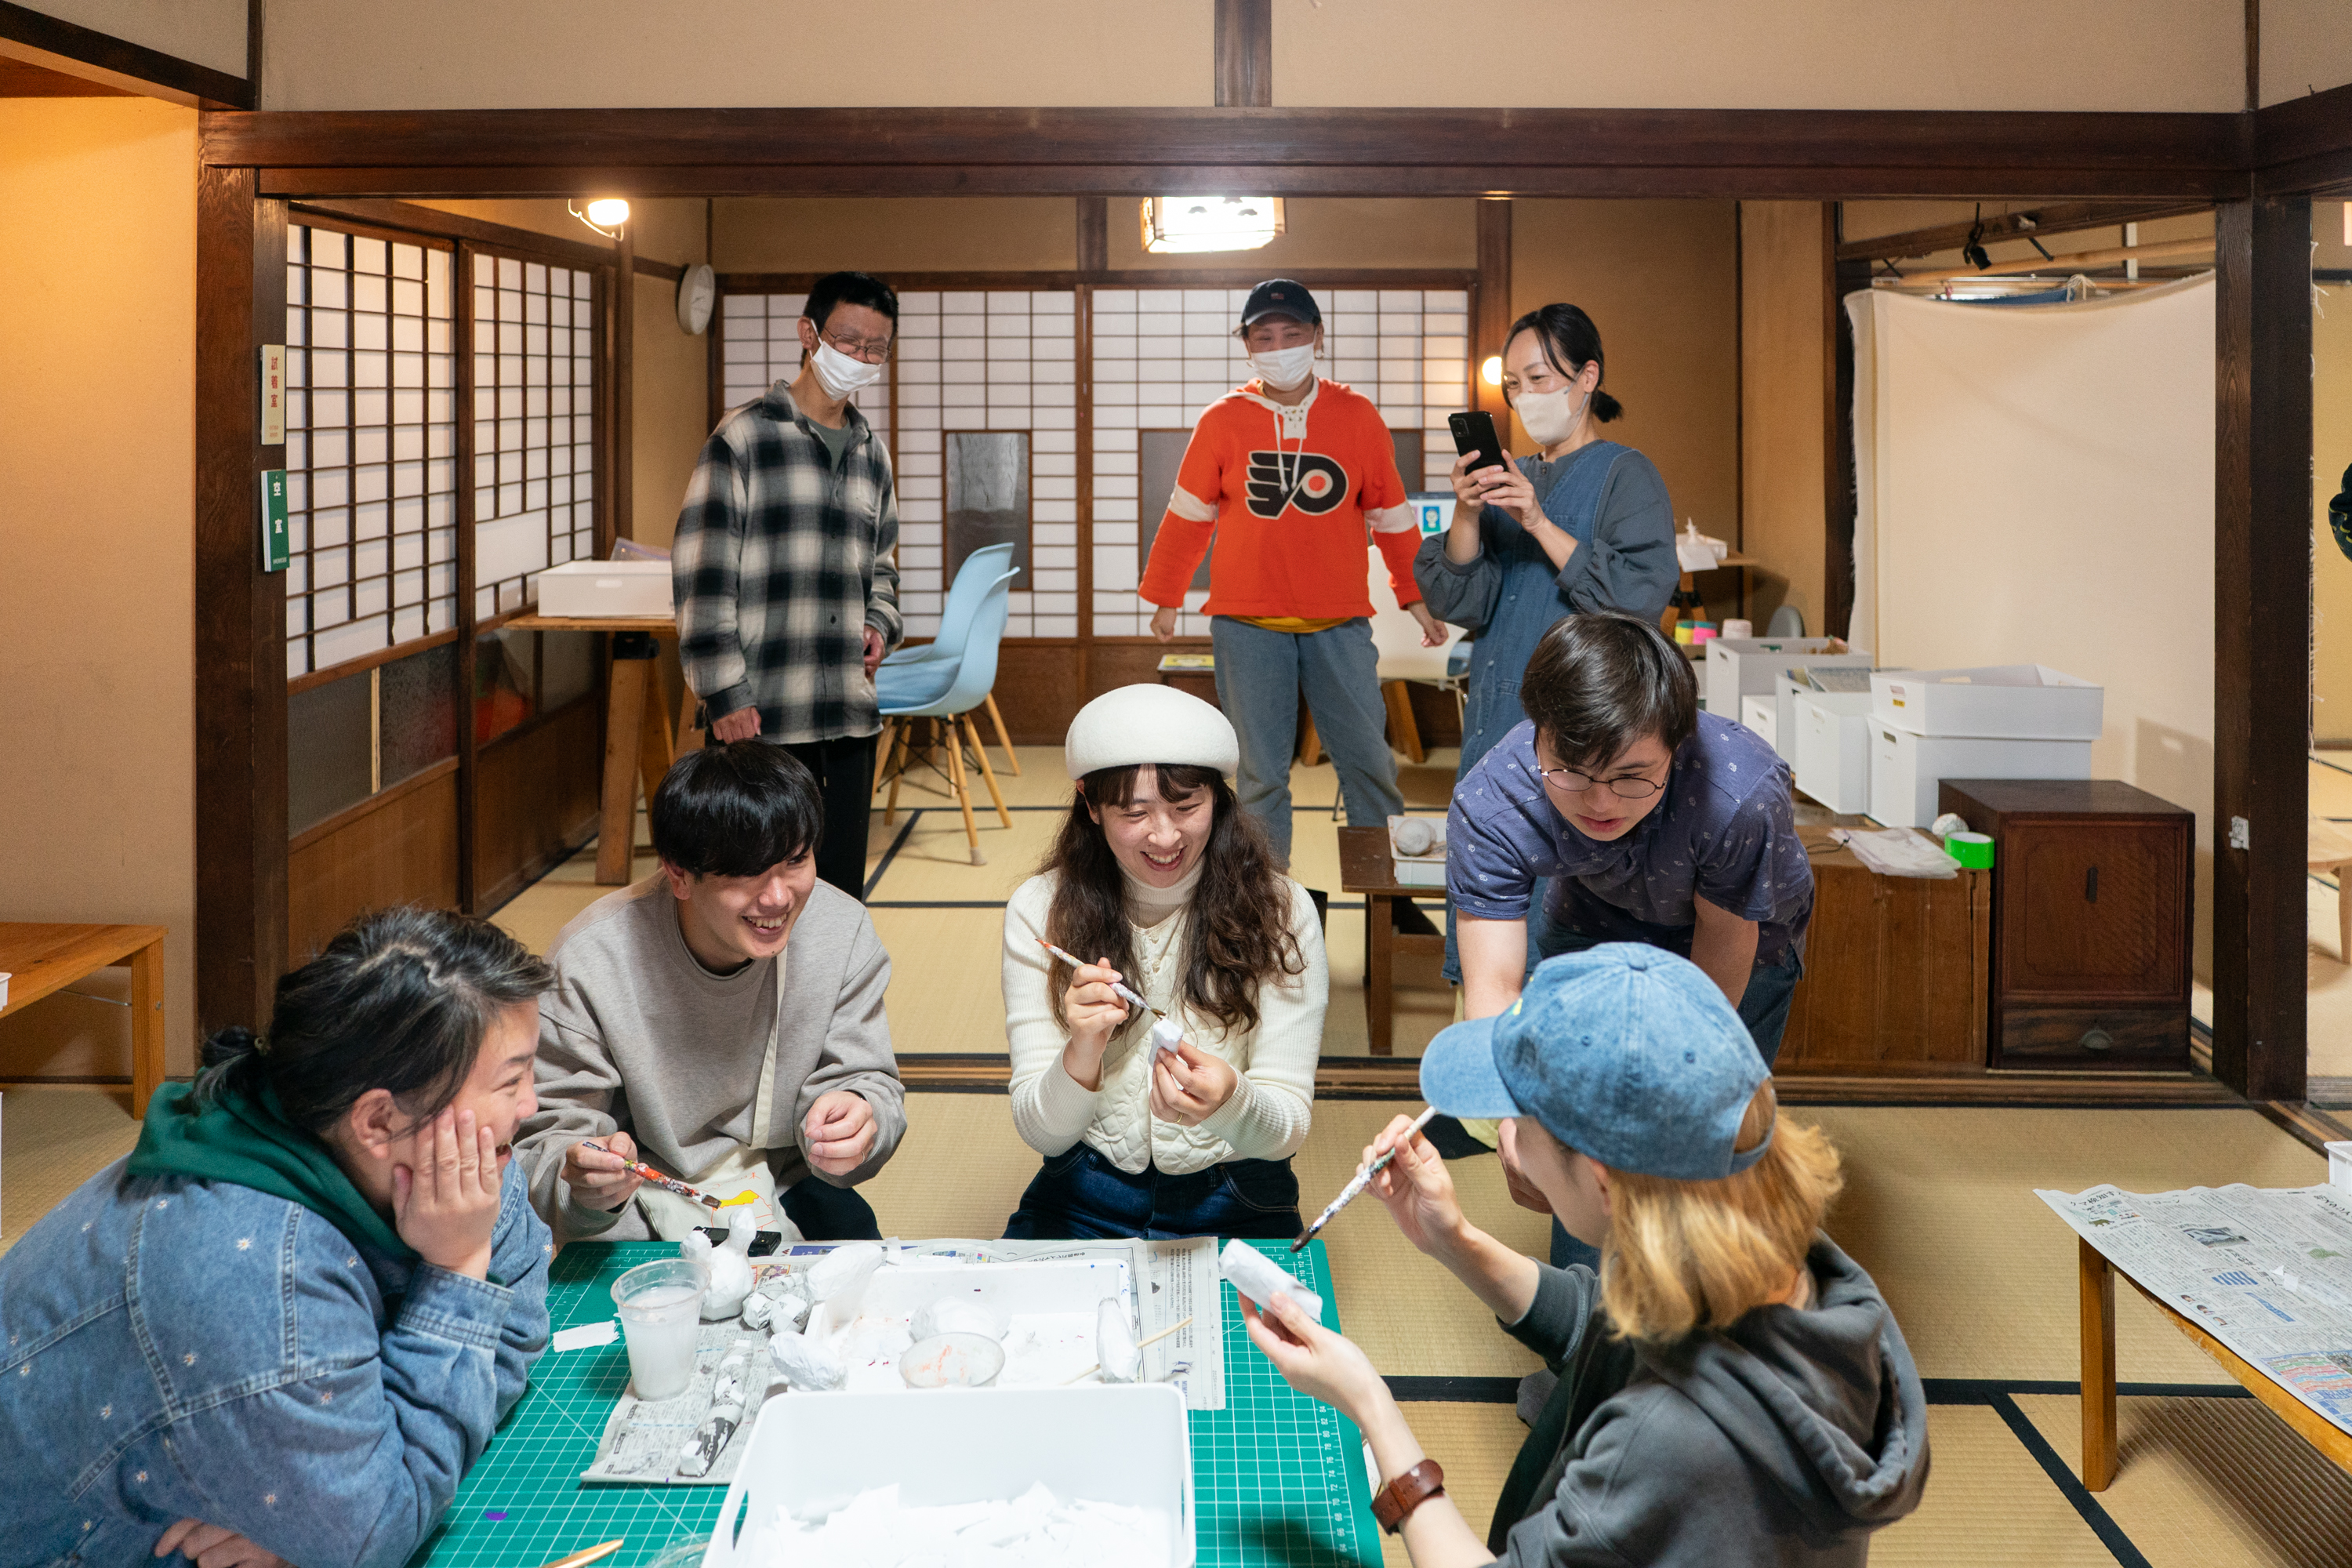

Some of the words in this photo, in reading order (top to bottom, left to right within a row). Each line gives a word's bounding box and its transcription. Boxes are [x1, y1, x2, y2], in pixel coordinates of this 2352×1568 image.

[273, 481, 283, 534] 空室
[1324, 1443, 1332, 1451] 78
[1326, 1456, 1334, 1465] 76
[1328, 1469, 1336, 1478] 74
[1330, 1483, 1338, 1492] 72
[1332, 1497, 1341, 1507] 70
[1334, 1512, 1343, 1522] 68
[1336, 1527, 1345, 1537] 66
